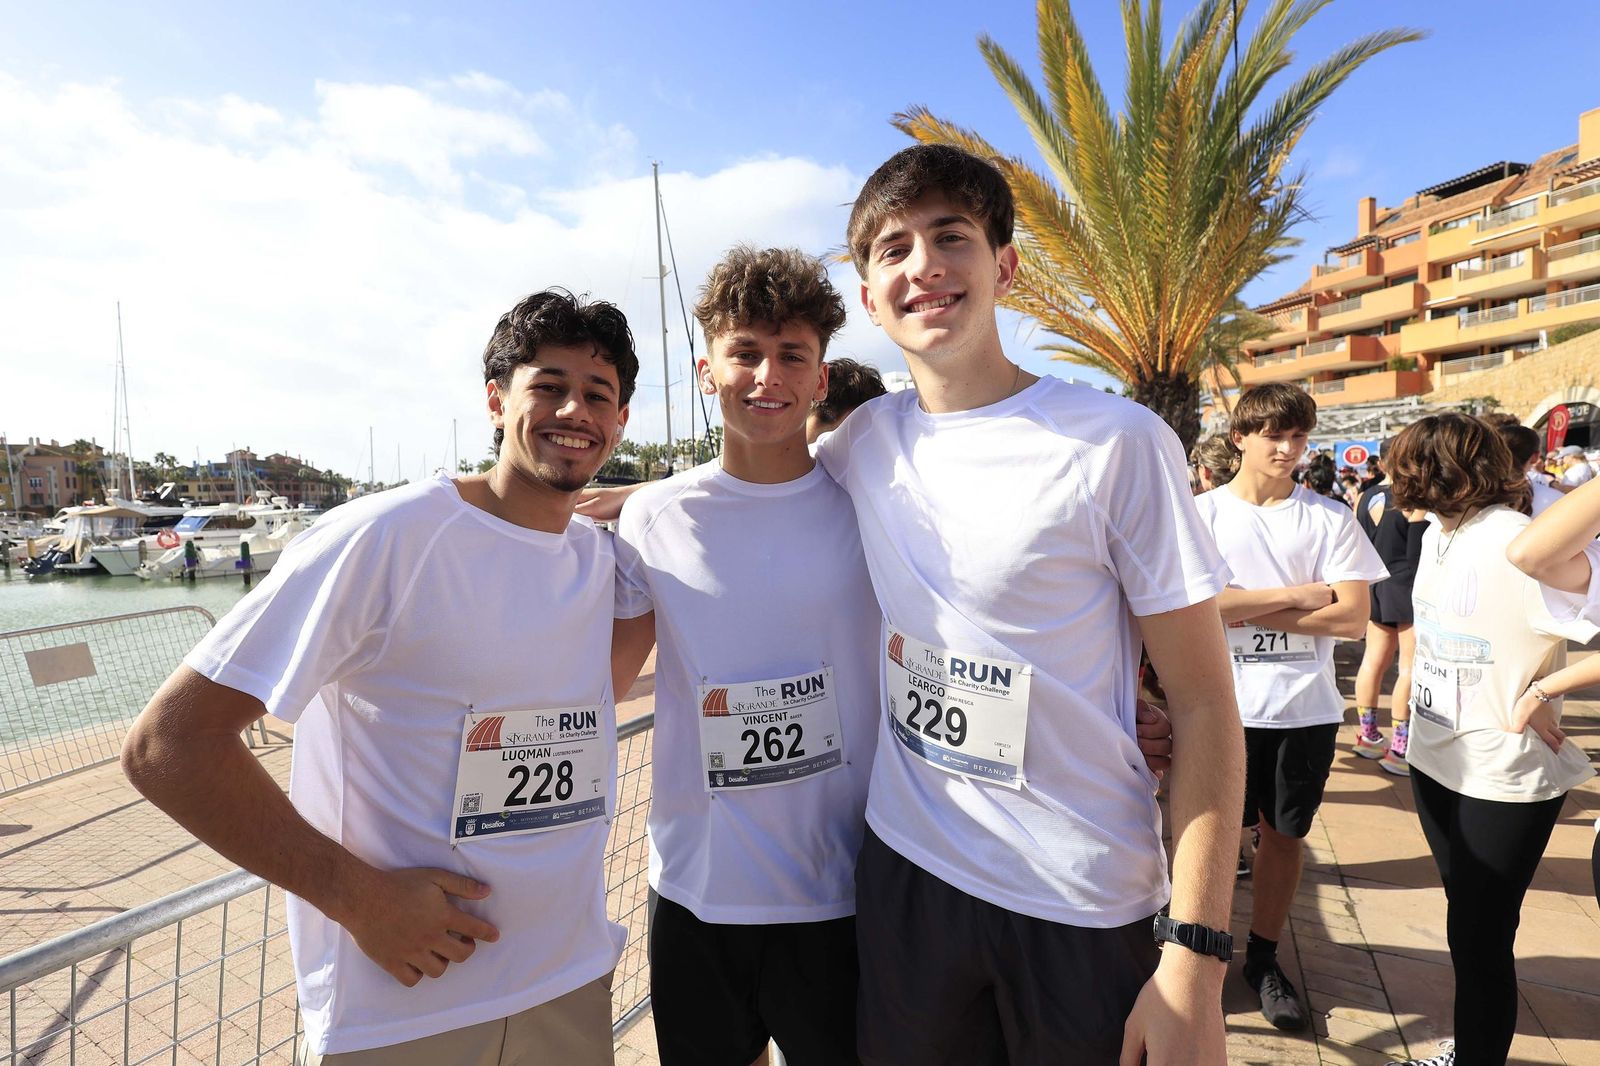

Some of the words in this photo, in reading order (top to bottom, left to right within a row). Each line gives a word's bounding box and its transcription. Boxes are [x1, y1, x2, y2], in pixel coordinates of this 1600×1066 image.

[1253, 632, 1288, 652] 271
[925, 649, 944, 666] The
[950, 657, 1012, 687] RUN
[1424, 662, 1446, 678] RUN
[755, 687, 776, 697] The
[781, 674, 824, 699] RUN
[908, 674, 945, 698] LEARCO
[958, 680, 979, 690] Charity
[980, 684, 1010, 696] Challenge
[1415, 682, 1432, 708] 70
[790, 697, 806, 705] Charity
[807, 692, 825, 701] Challenge
[536, 716, 555, 727] The
[559, 711, 597, 731] RUN
[742, 712, 788, 725] VINCENT
[906, 690, 967, 746] 229
[741, 723, 805, 764] 262
[999, 749, 1004, 757] L
[502, 747, 551, 761] LUQMAN
[974, 764, 1008, 777] BETANIA
[504, 760, 573, 807] 228
[594, 784, 598, 792] L
